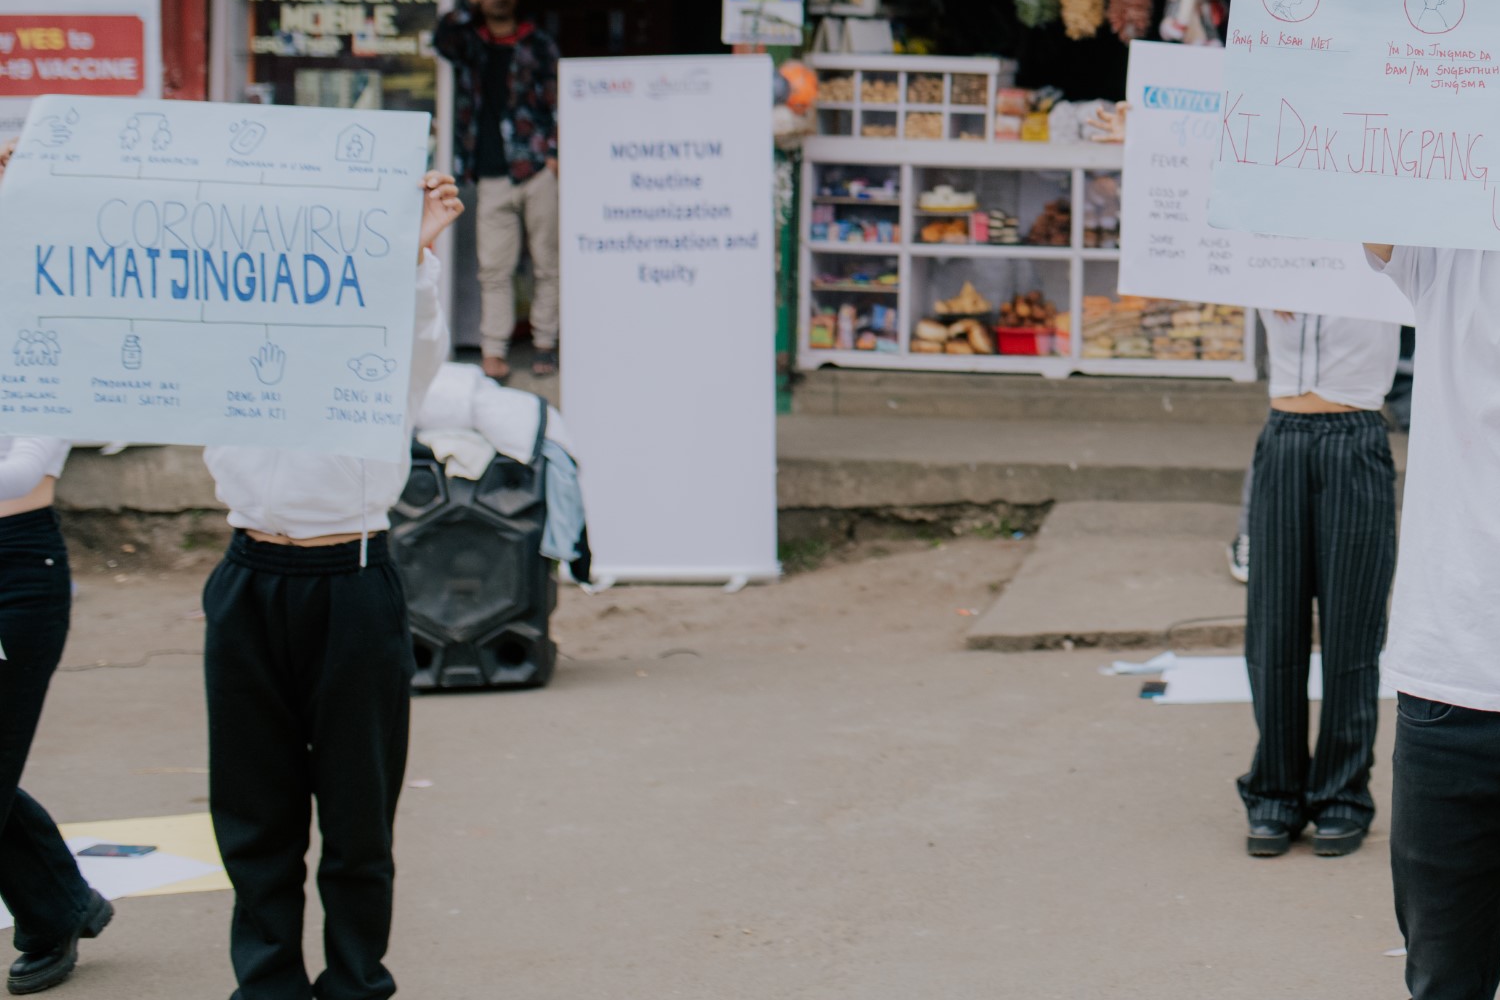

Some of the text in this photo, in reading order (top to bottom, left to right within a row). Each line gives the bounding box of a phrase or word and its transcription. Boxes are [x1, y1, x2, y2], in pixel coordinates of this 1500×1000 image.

[280, 2, 400, 37] MOBILE
[15, 27, 66, 51] YES
[67, 29, 96, 52] to
[1231, 29, 1252, 53] PANG
[1278, 31, 1304, 47] KSAH
[1310, 35, 1334, 50] MET
[1406, 43, 1425, 57] DON
[34, 57, 139, 82] VACCINE
[609, 141, 723, 160] MOMENTUM
[1218, 89, 1490, 190] KI DAK JINGPANG
[1150, 153, 1191, 169] FEVER
[630, 171, 703, 190] Routine
[602, 200, 733, 221] Immunization
[96, 198, 391, 258] CORONAVIRUS
[577, 230, 759, 253] Transformation and
[636, 263, 698, 285] Equity
[333, 386, 369, 404] DENG
